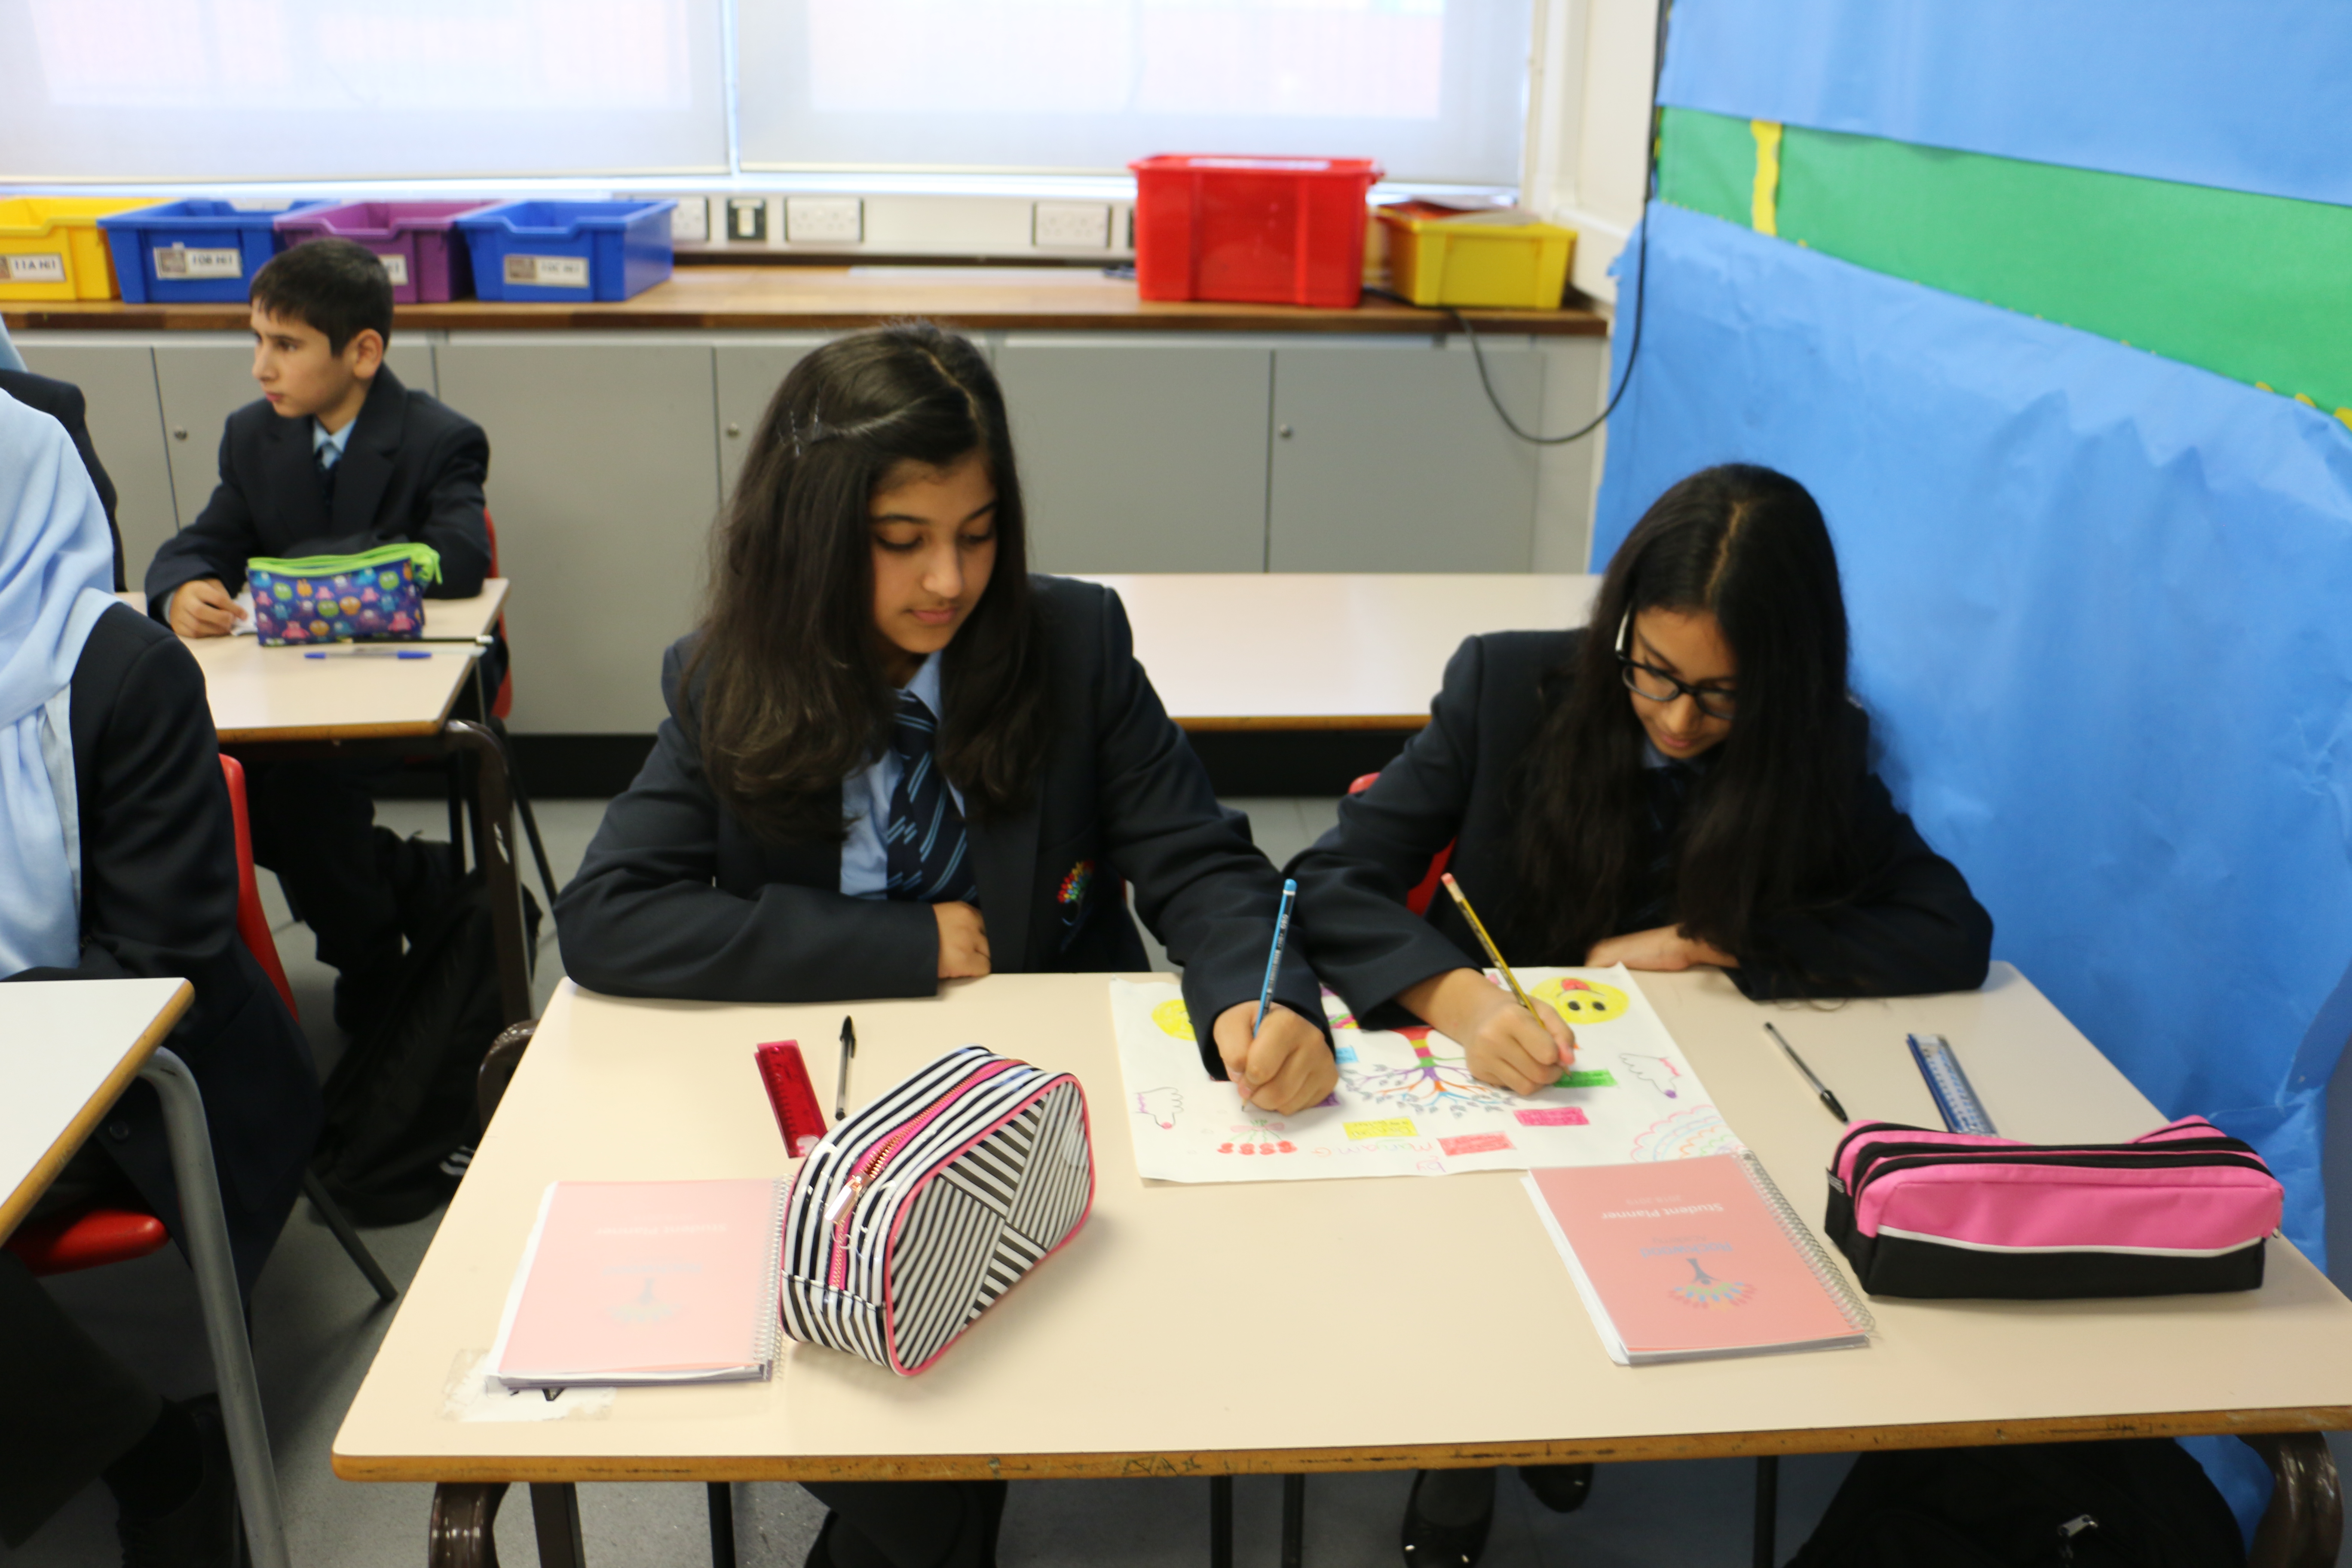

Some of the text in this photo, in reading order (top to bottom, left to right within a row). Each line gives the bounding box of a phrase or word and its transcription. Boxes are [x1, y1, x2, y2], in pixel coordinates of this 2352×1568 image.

[1602, 1203, 1724, 1220] Student Planner
[663, 1224, 727, 1234] Student
[1640, 1243, 1732, 1259] Rockwood
